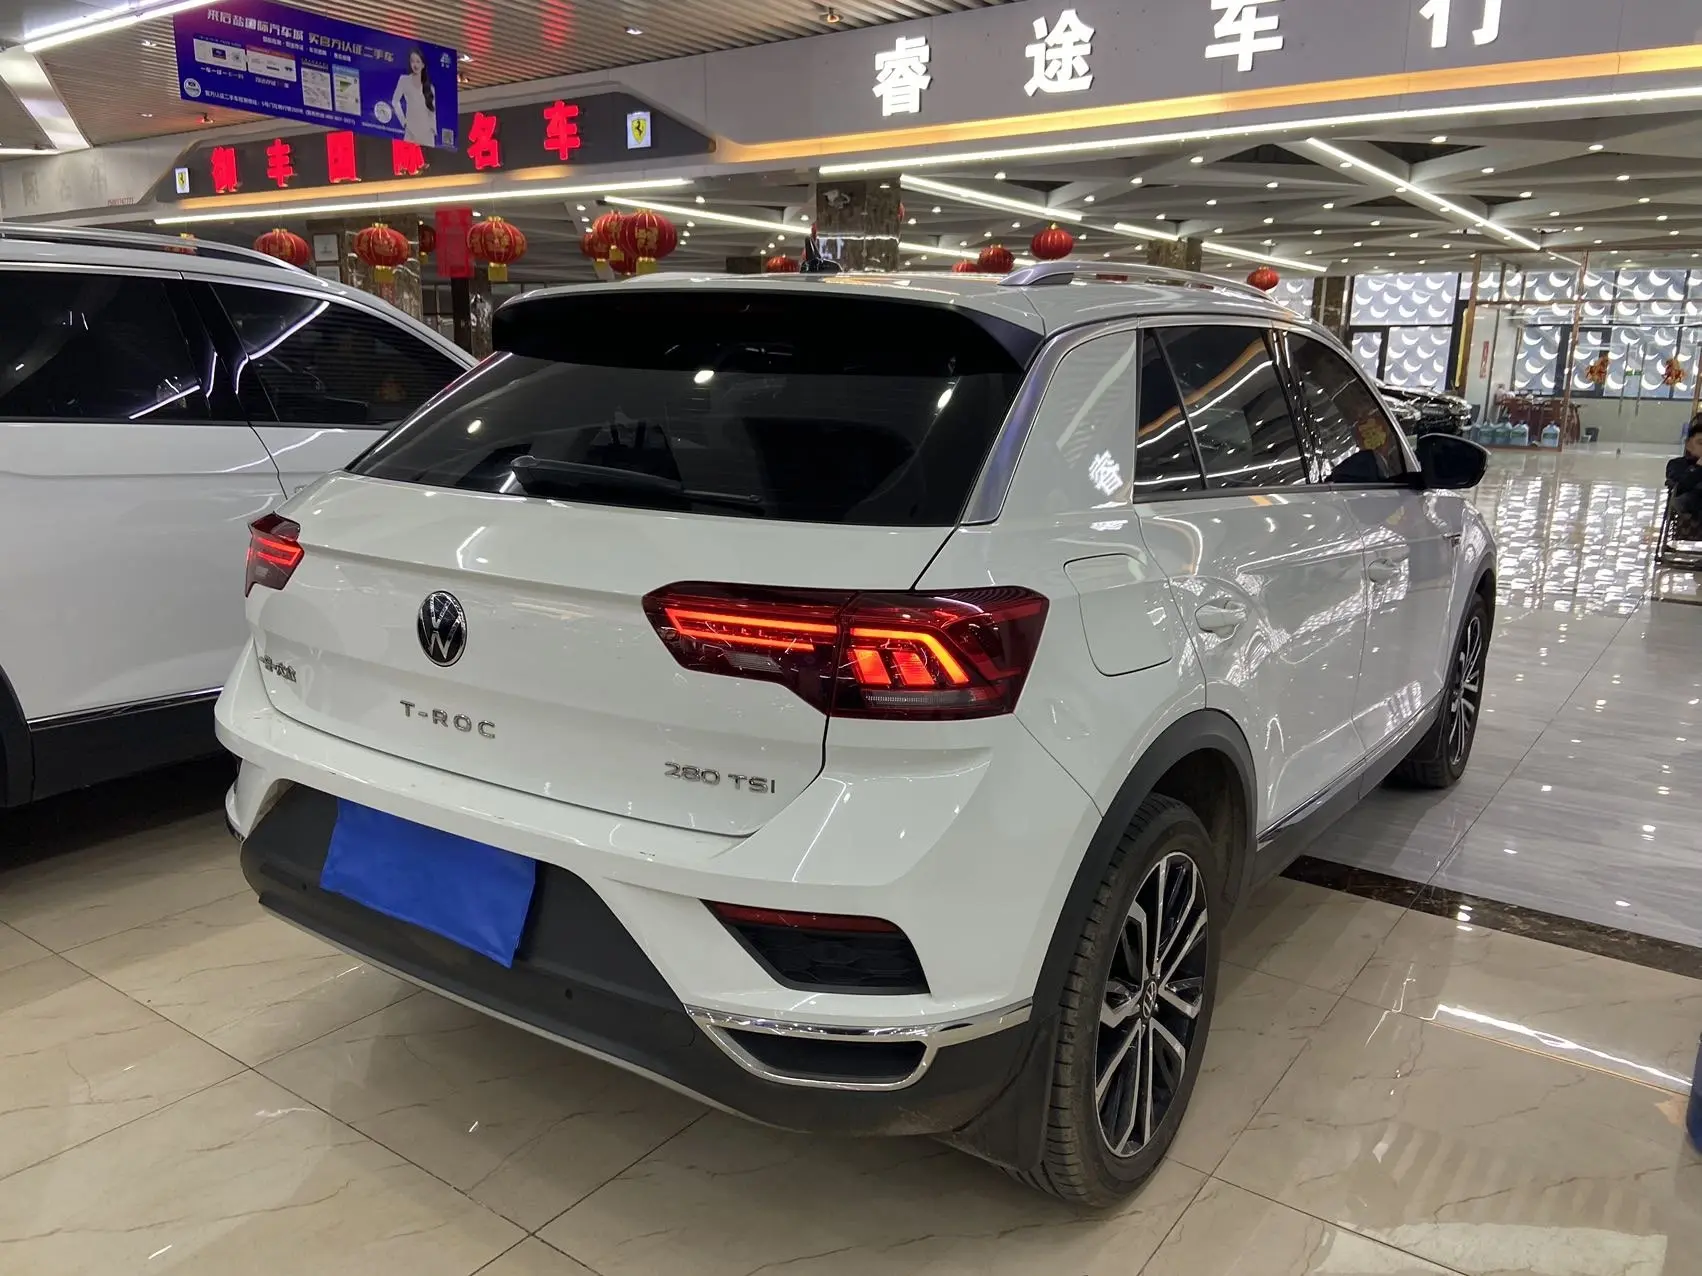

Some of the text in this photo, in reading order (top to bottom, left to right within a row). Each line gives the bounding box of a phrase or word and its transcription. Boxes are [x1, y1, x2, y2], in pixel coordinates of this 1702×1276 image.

[400, 699, 496, 739] T-ROC
[663, 761, 776, 793] 280 TSI
